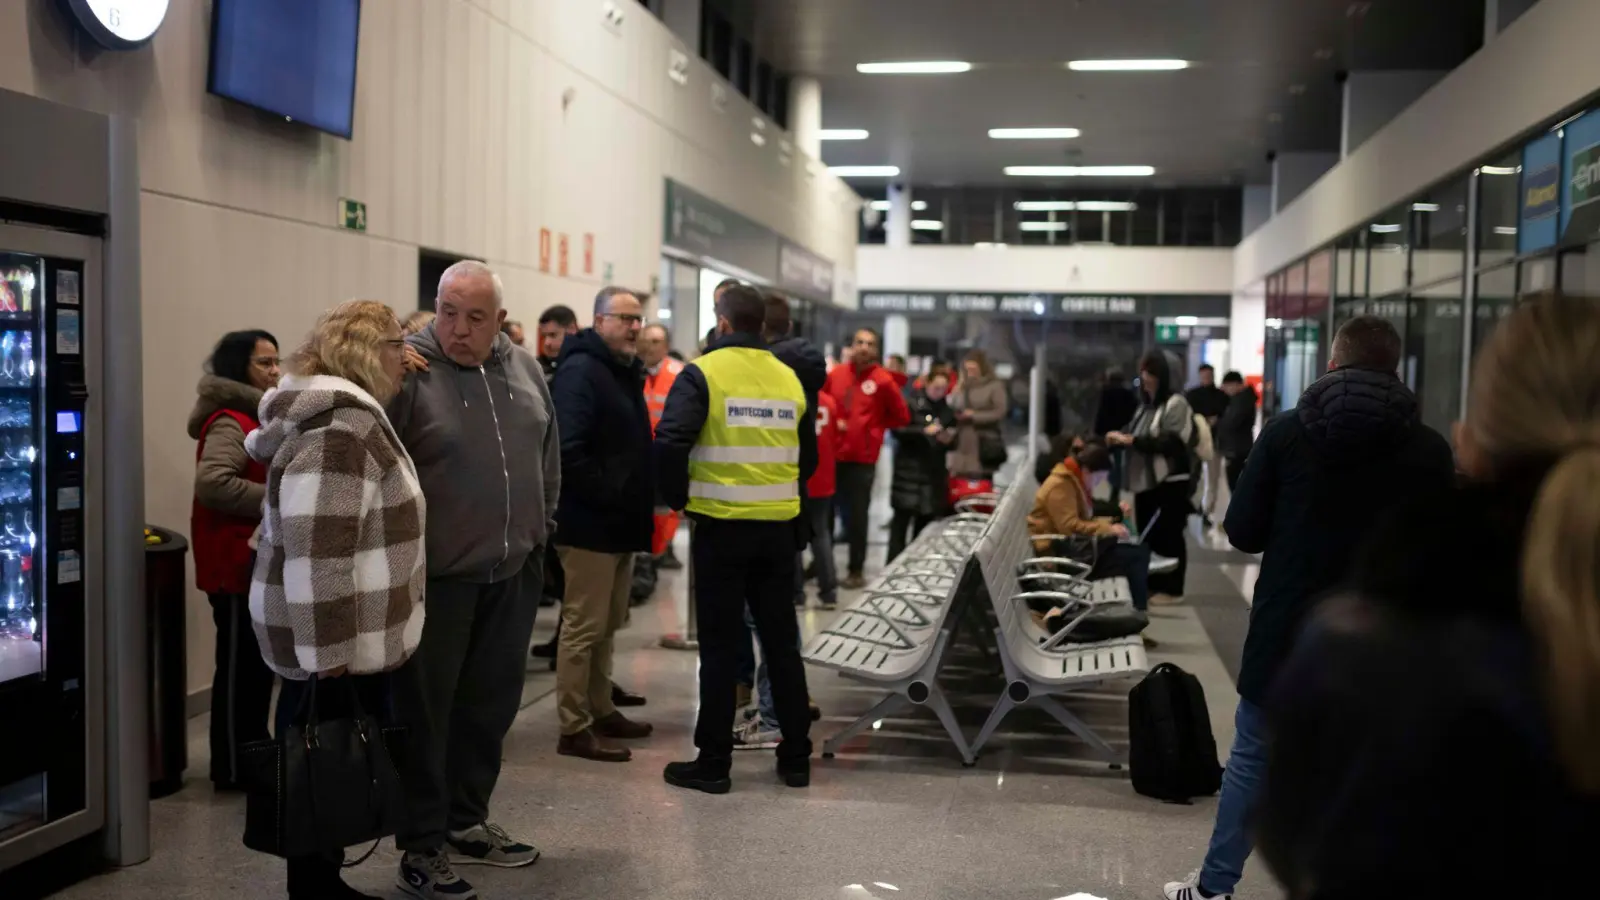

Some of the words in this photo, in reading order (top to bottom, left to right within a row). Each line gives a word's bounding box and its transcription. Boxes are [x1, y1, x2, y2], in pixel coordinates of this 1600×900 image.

[109, 7, 120, 27] 6
[908, 294, 935, 311] BAR
[1061, 296, 1106, 313] COFFEE
[1108, 297, 1135, 313] BAR
[777, 408, 795, 420] CIVIL
